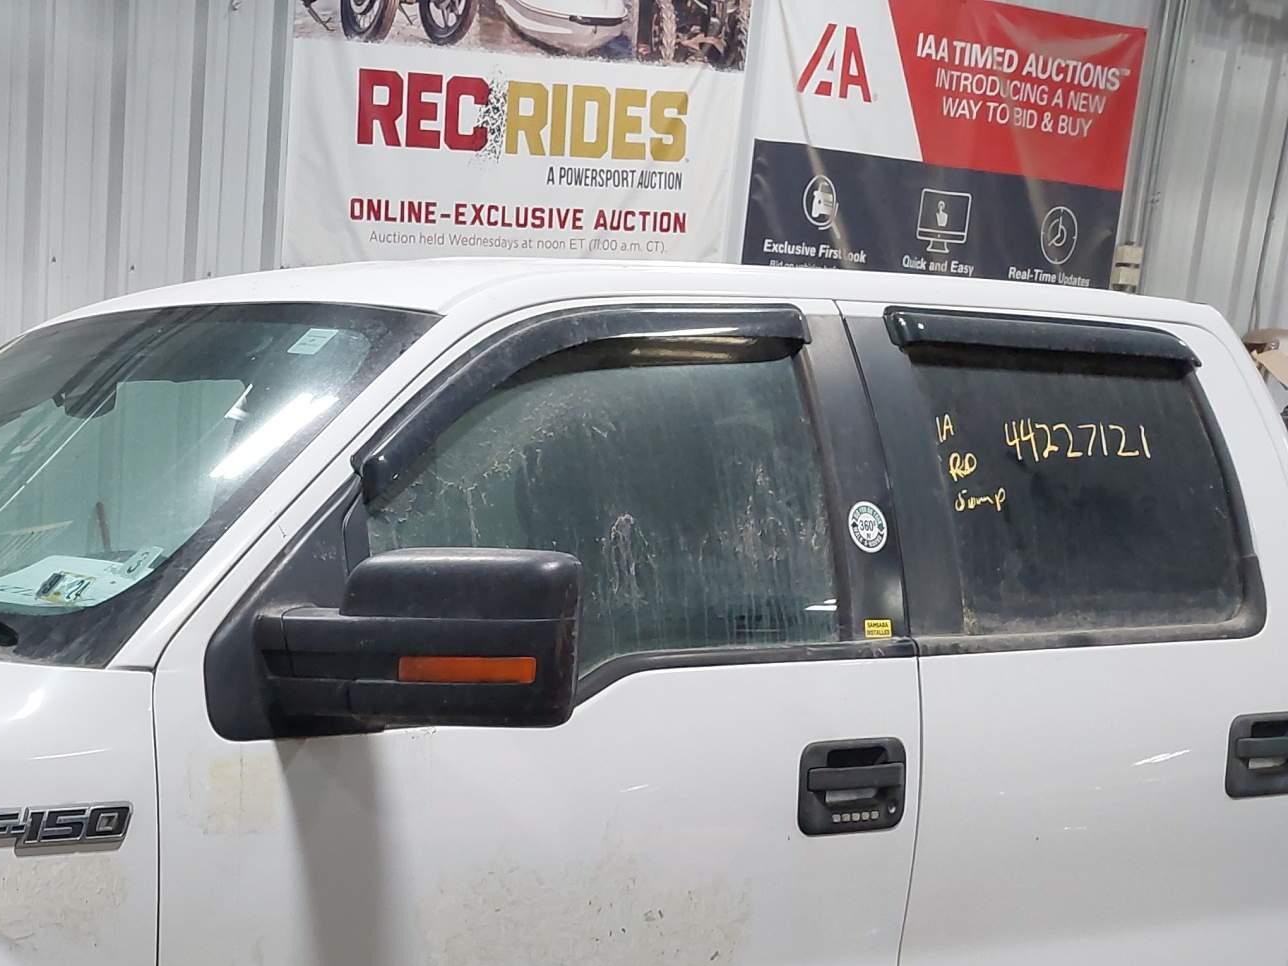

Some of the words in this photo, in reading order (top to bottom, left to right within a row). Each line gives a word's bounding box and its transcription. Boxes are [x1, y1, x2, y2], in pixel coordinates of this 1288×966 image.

[916, 32, 949, 62] IAA
[953, 40, 1019, 73] TIMED
[935, 67, 1049, 106] INTRODUCING
[1051, 91, 1064, 109] A
[1067, 91, 1107, 114] NEW
[356, 67, 490, 153] REC
[505, 80, 688, 162] RIDES
[942, 96, 983, 120] WAY
[986, 101, 1010, 125] TO
[1013, 106, 1038, 129] BID
[1041, 111, 1053, 133] &
[1057, 114, 1093, 137] BUY
[546, 165, 555, 186] A
[559, 166, 636, 189] POWERSPORT
[636, 169, 683, 190] AUCTION
[349, 197, 584, 231] ONLINE-EXCLUSIVE
[593, 208, 687, 234] AUCTION
[369, 230, 416, 246] Auction
[419, 231, 445, 246] held
[449, 233, 519, 252] Wednesdays
[520, 238, 533, 250] at
[536, 239, 567, 250] noon
[569, 238, 585, 251] ET
[762, 238, 817, 257] Exclusive
[817, 243, 842, 260] First
[901, 254, 926, 271] Quick
[928, 259, 948, 273] and
[950, 260, 975, 277] Easy
[1008, 265, 1057, 284] Real-Time
[1058, 272, 1091, 287] Updates
[1004, 417, 1152, 462] 44227121
